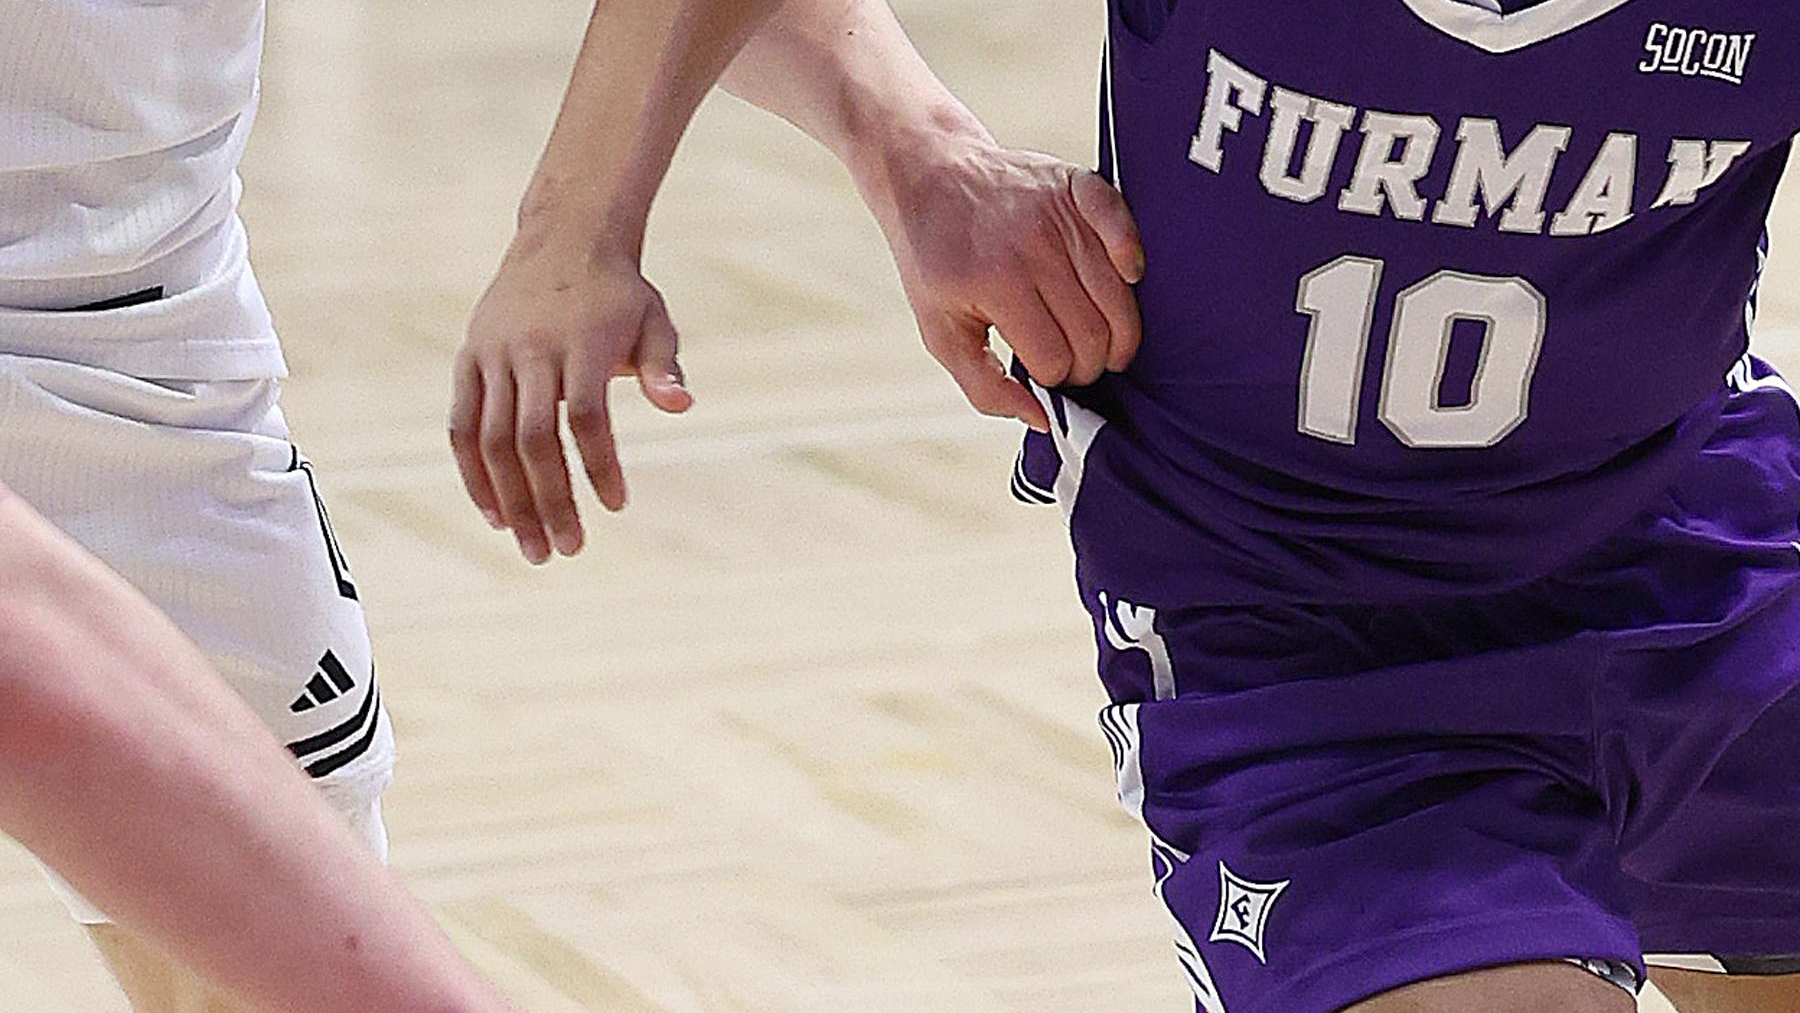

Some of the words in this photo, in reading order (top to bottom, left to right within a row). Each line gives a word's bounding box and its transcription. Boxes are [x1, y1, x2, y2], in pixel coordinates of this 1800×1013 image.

[1188, 46, 1752, 237] FURMAN
[1639, 22, 1756, 84] SOCON
[1295, 254, 1546, 449] 10
